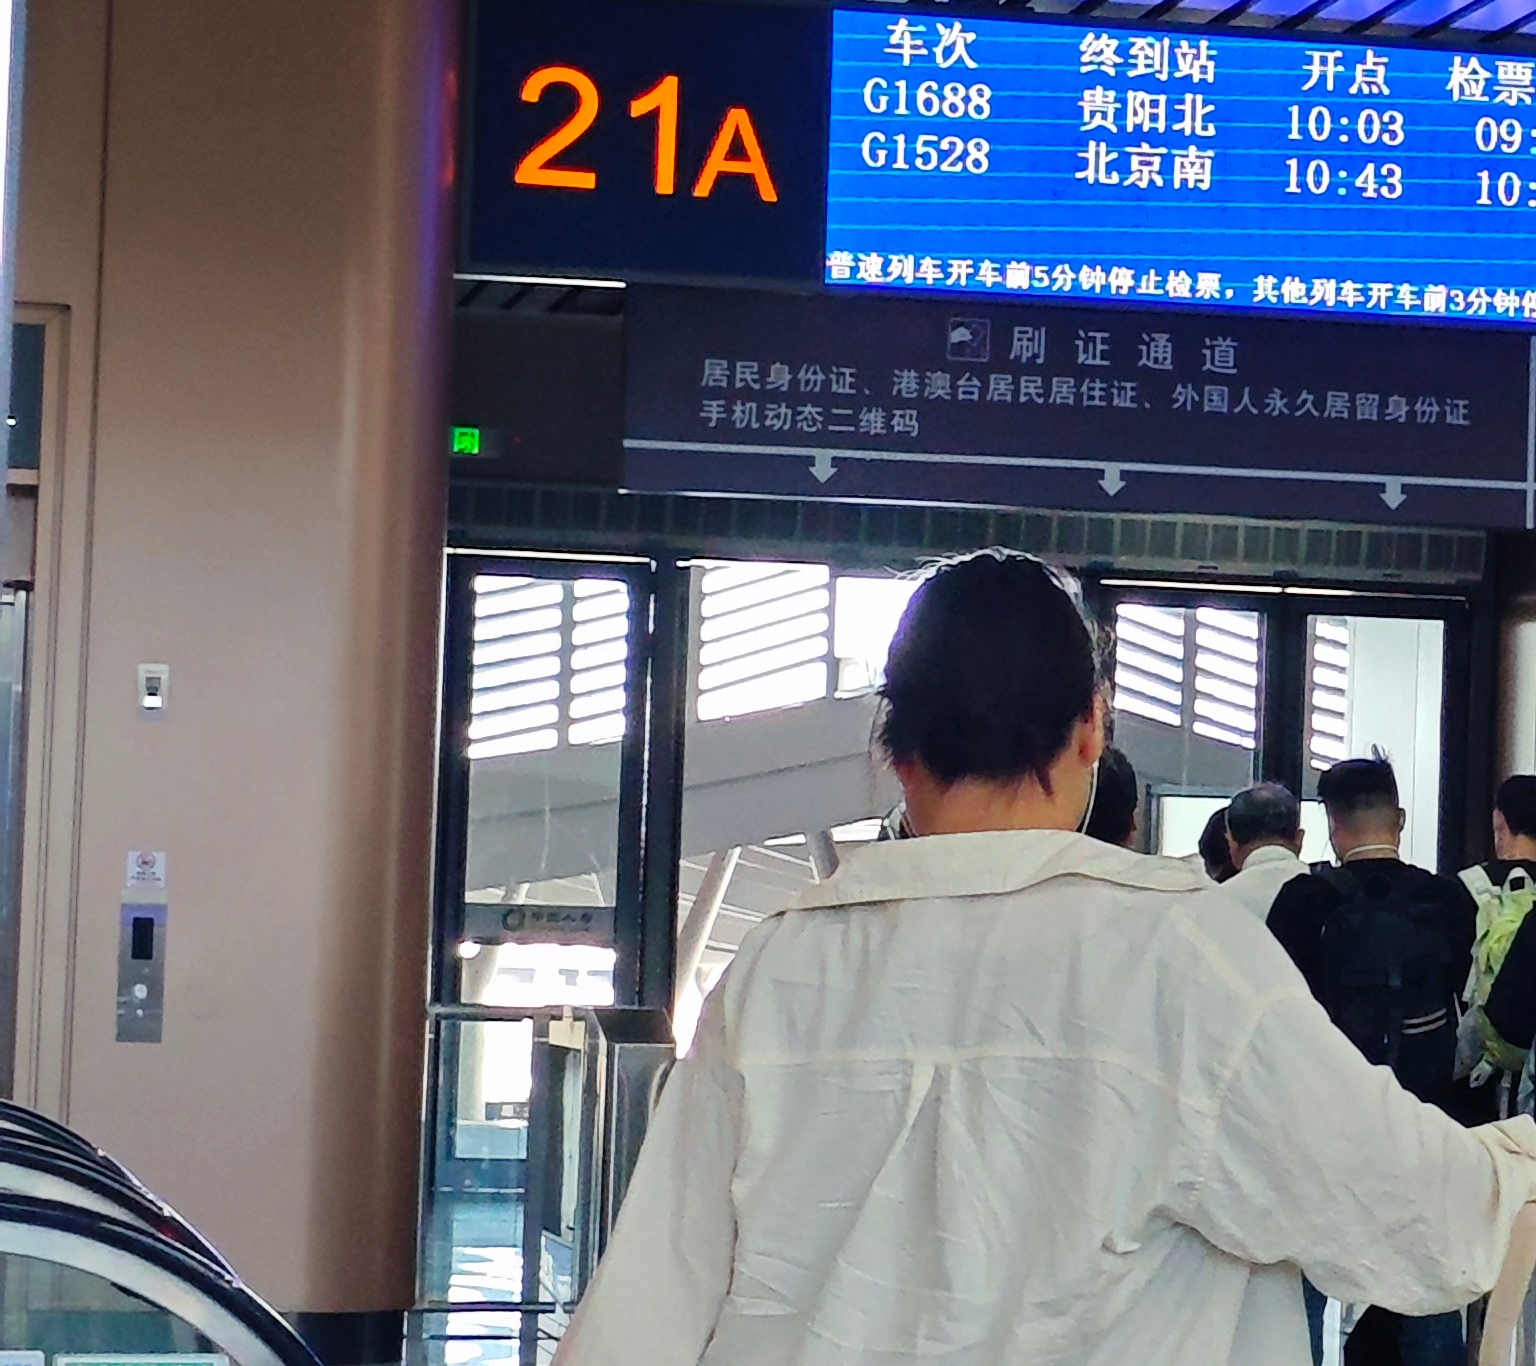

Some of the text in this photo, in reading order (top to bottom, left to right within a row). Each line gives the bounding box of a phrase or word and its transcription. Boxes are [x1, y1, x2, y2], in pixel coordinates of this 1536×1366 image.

[885, 18, 977, 68] 车次
[1080, 33, 1215, 83] 终到站
[1303, 50, 1389, 95] 开点
[515, 67, 777, 201] 21A
[864, 78, 991, 119] G1688
[1079, 86, 1215, 136] 贵阳北
[1289, 105, 1404, 145] 10:03
[862, 132, 989, 173] G1528
[1076, 141, 1214, 190] 北京南
[1286, 158, 1402, 198] 10:43
[1009, 326, 1238, 374] 刷证通道
[699, 399, 920, 437] 手机动态二维码
